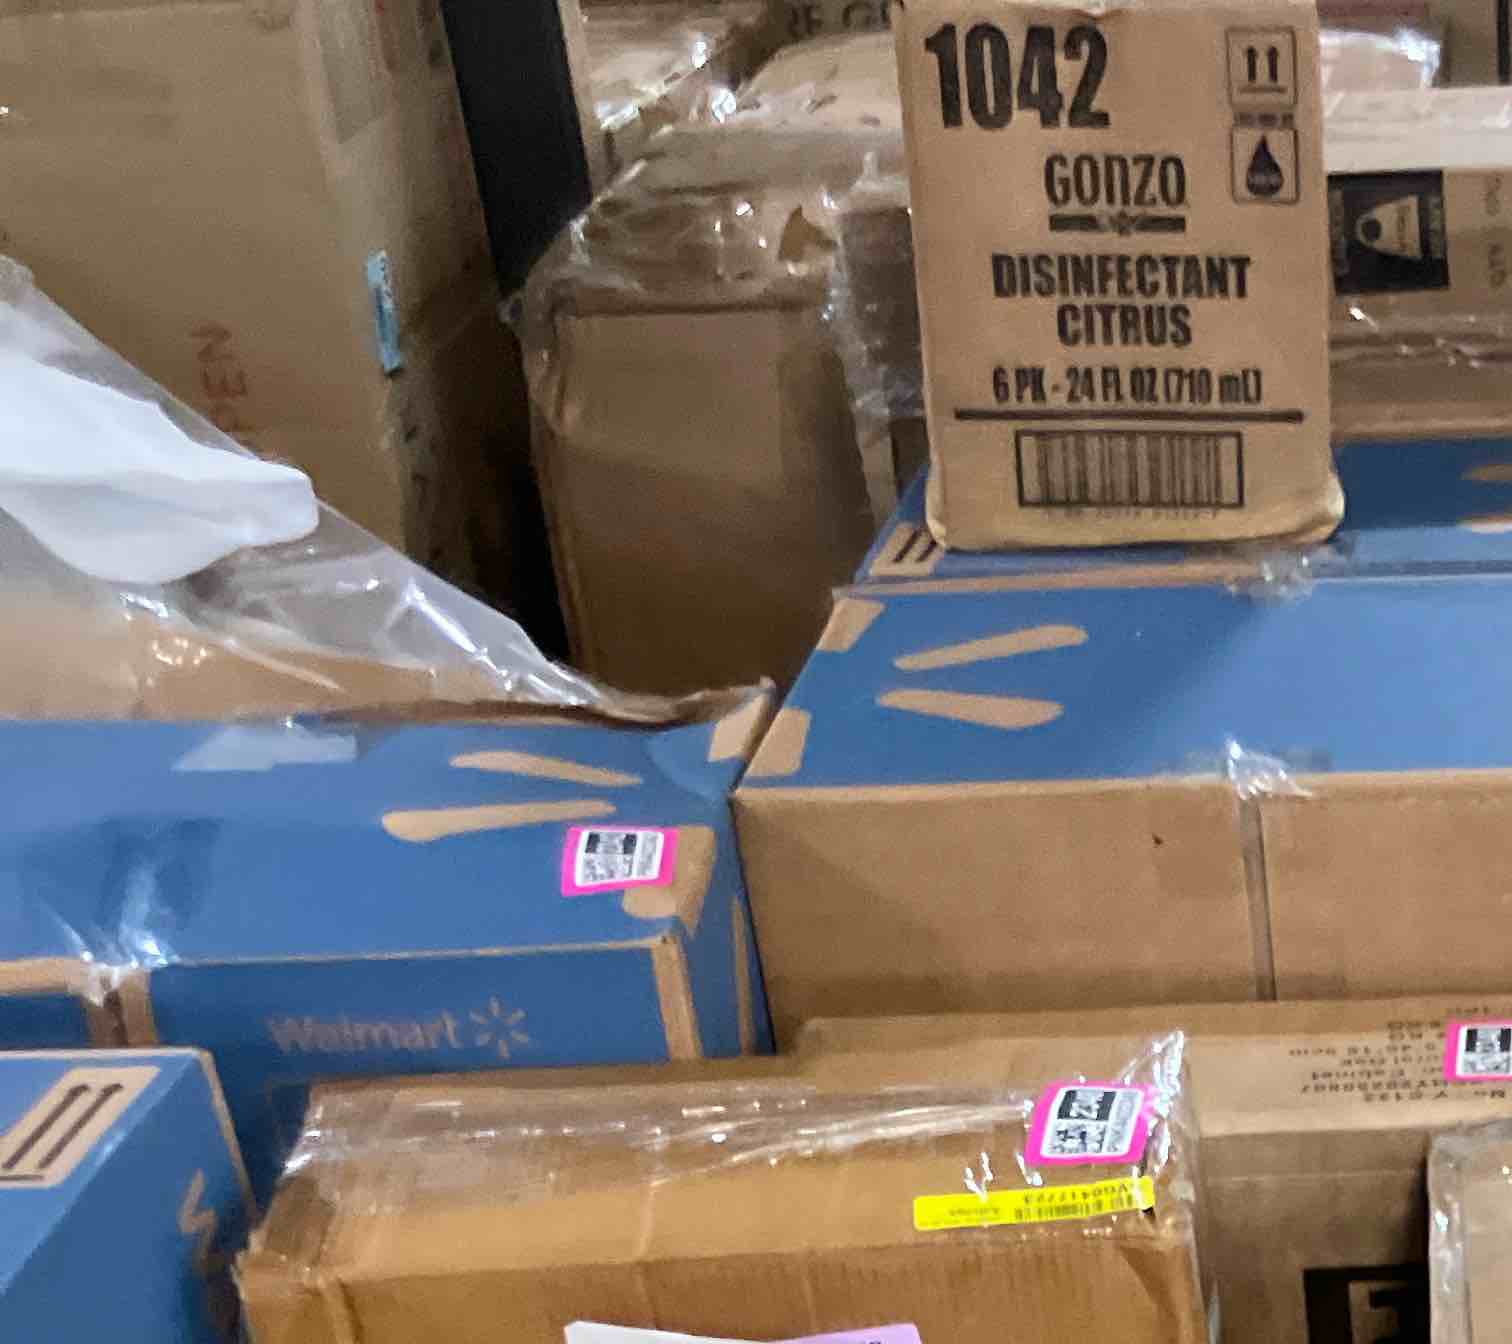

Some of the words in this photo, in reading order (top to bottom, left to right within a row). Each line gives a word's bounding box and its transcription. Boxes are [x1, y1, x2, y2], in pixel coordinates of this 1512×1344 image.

[925, 22, 1111, 129] 1042
[991, 252, 1251, 299] DISINFECTANT
[1056, 303, 1193, 348] CITRUS
[992, 365, 1010, 404] 6
[1065, 365, 1096, 402] 24
[1101, 367, 1123, 404] FL
[1129, 367, 1158, 403] OZ
[268, 1008, 463, 1057] Walmart
